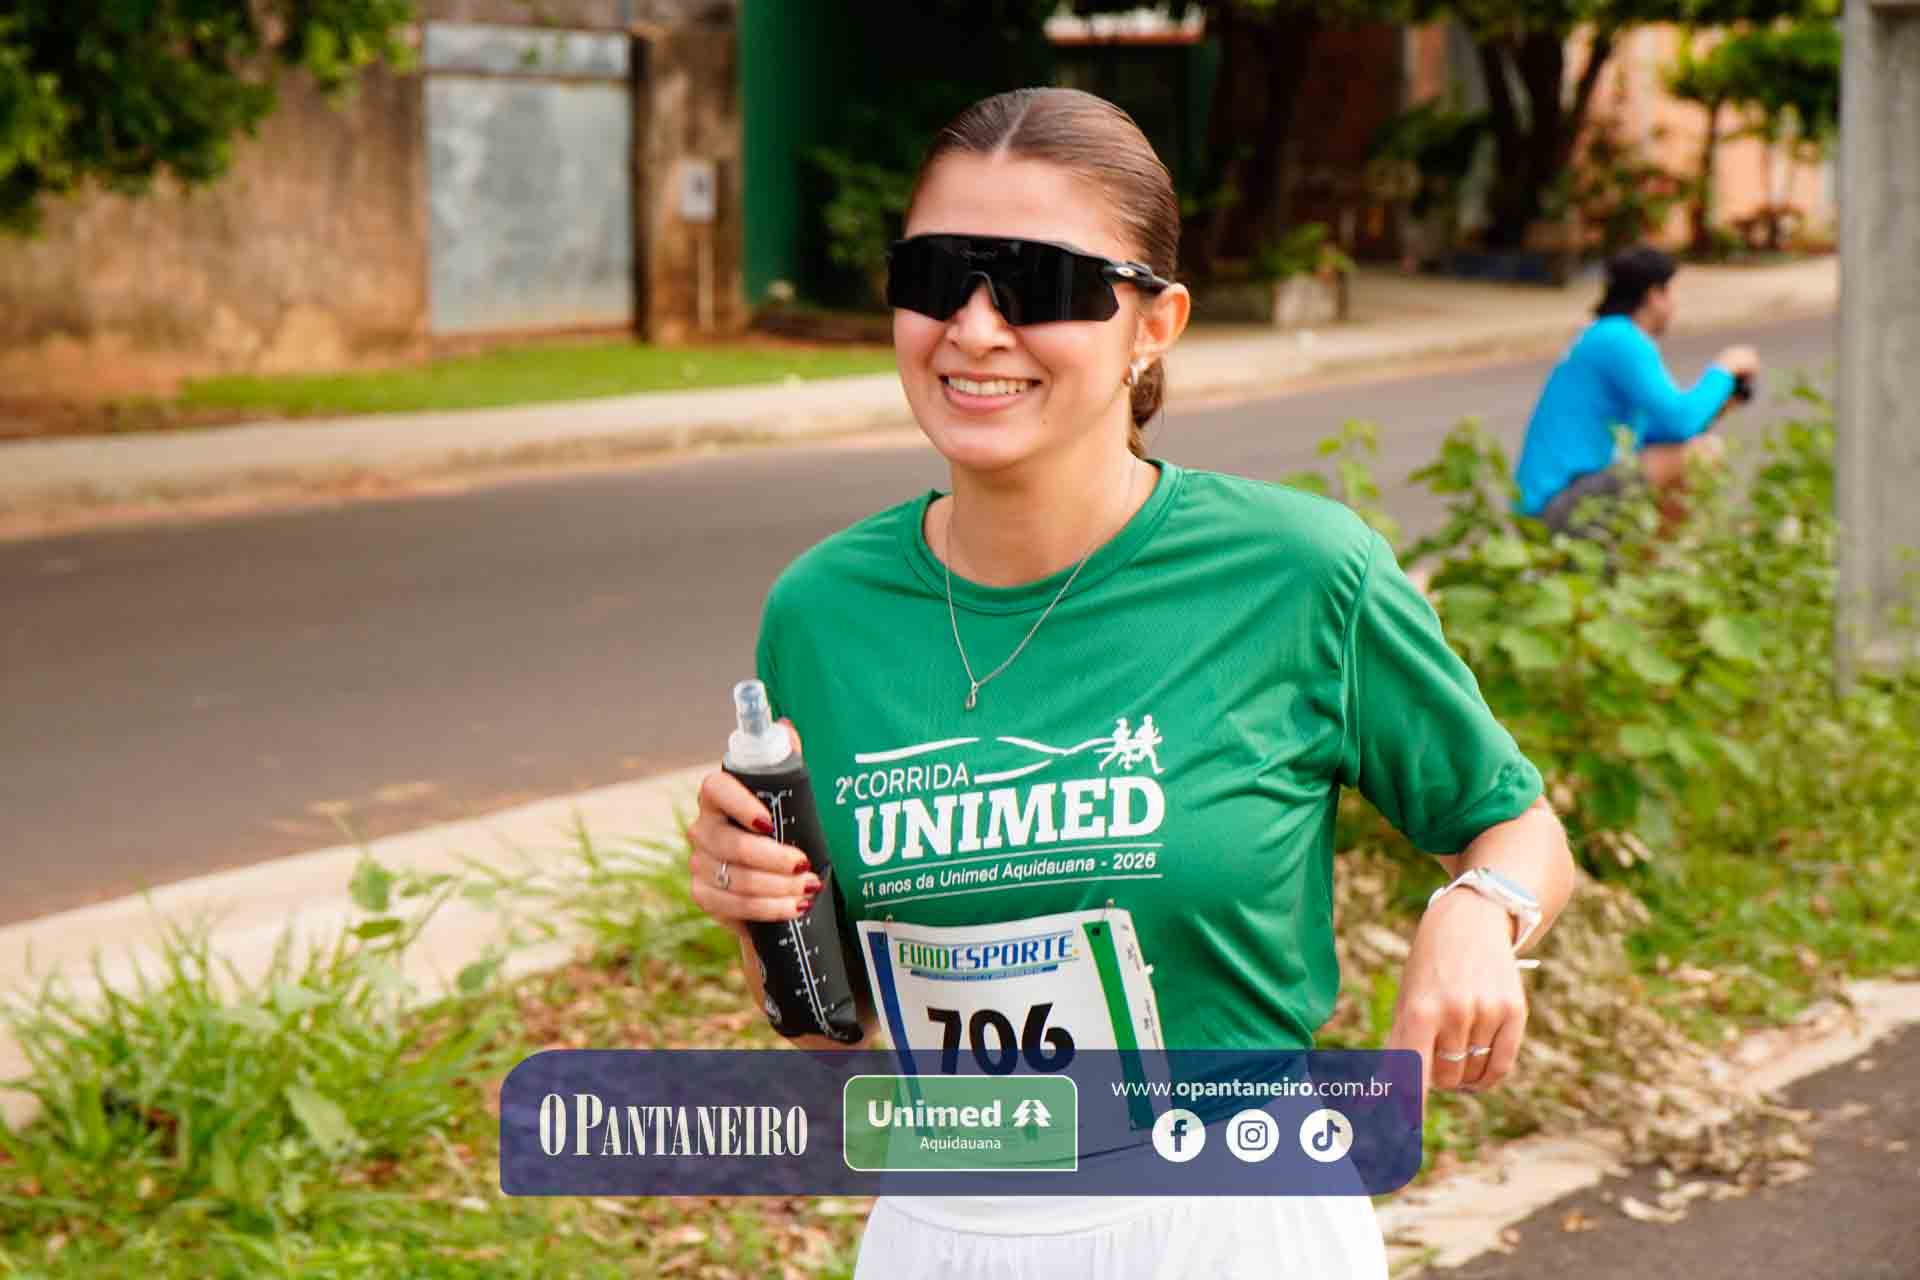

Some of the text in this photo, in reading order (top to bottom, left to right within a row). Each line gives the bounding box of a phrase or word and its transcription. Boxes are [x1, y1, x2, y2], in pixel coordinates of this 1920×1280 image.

[854, 762, 969, 800] CORRIDA
[855, 776, 1165, 866] UNIMED
[861, 880, 875, 897] 41
[878, 878, 912, 897] anos
[915, 873, 935, 890] da
[939, 863, 999, 887] Unimed
[1001, 858, 1095, 881] Aquidauana
[1112, 852, 1157, 870] 2026
[898, 934, 1073, 970] FUNDESPORTE
[926, 1002, 1076, 1075] 706
